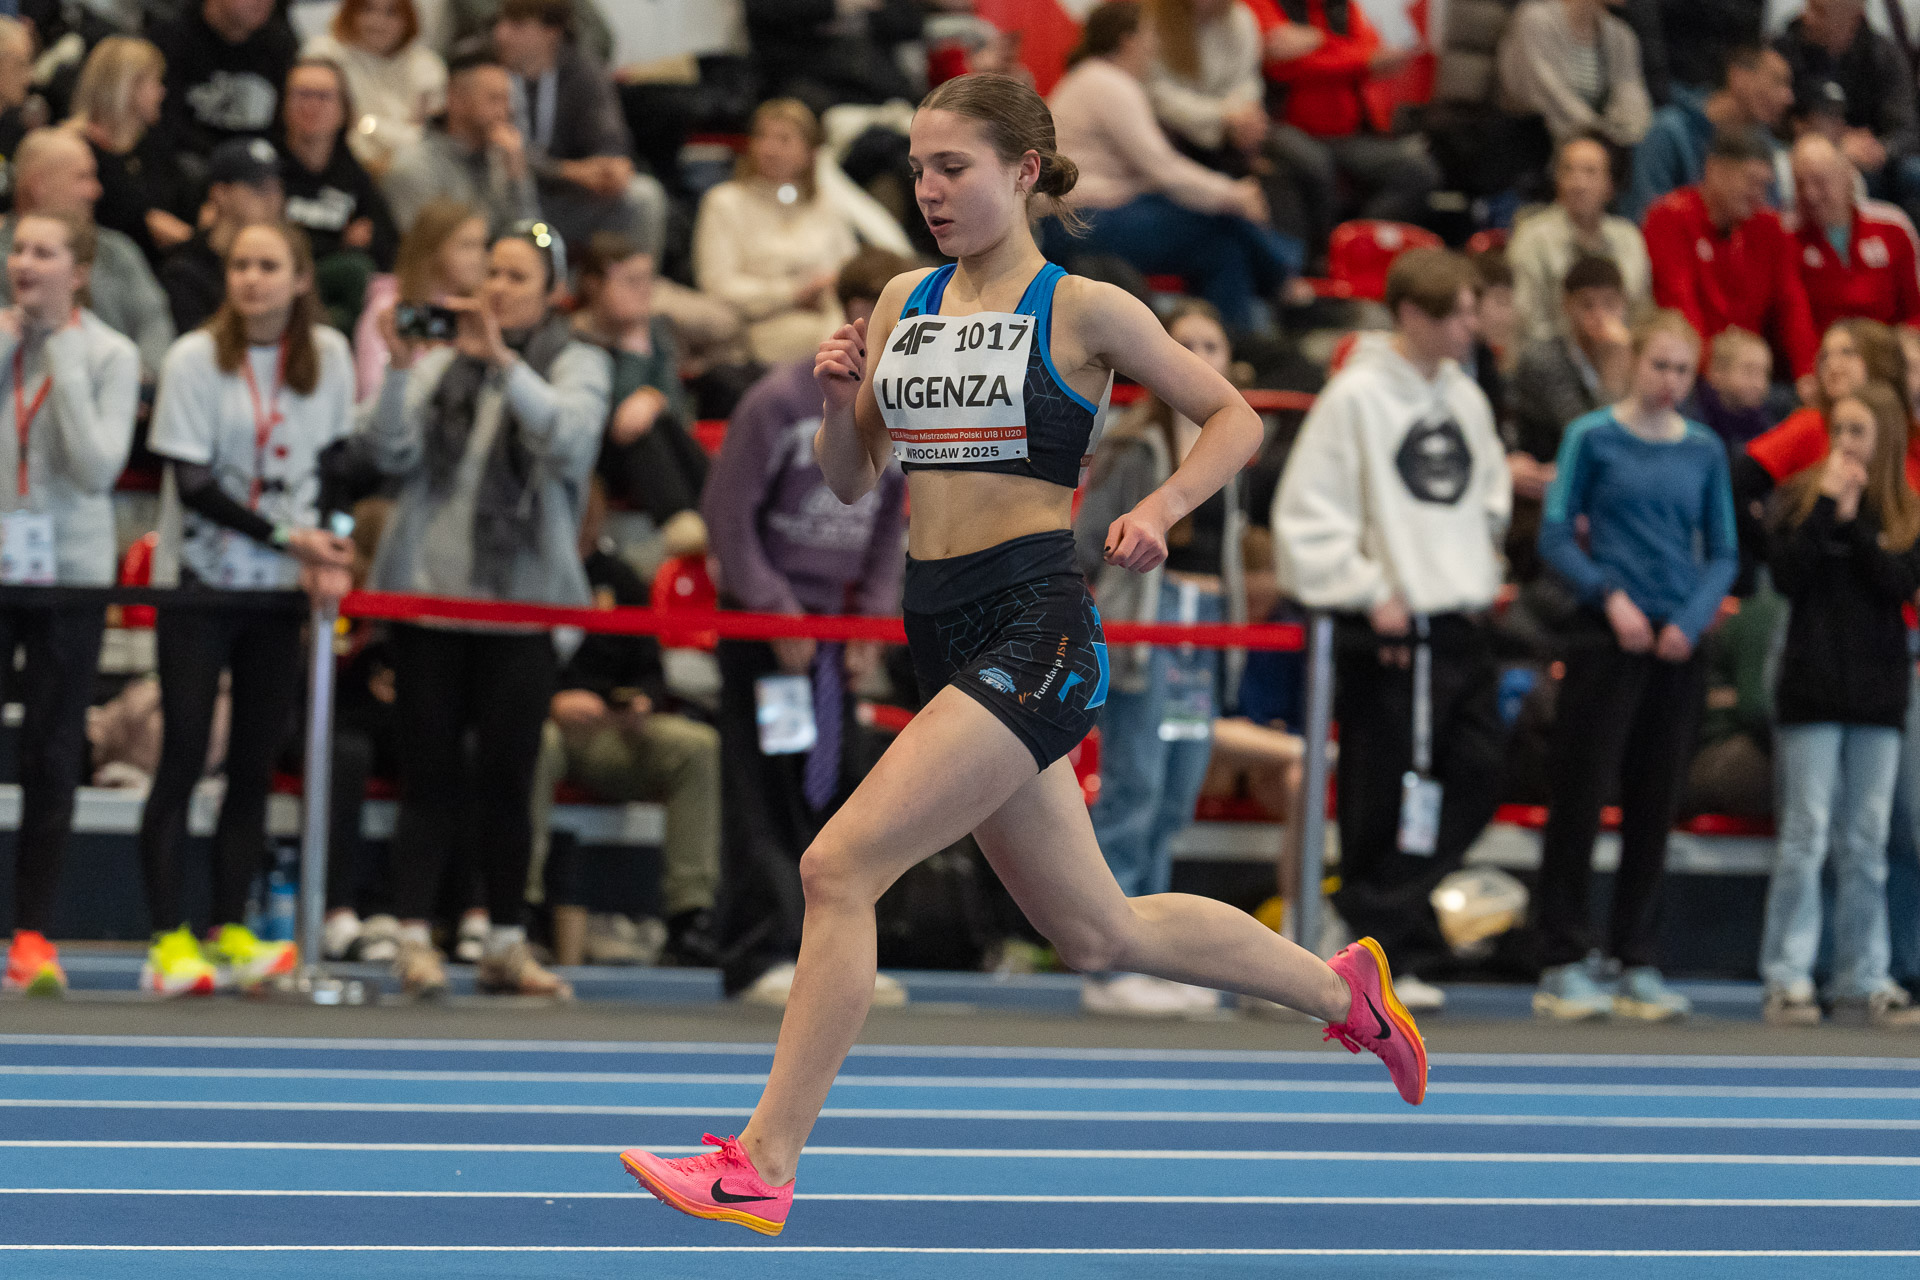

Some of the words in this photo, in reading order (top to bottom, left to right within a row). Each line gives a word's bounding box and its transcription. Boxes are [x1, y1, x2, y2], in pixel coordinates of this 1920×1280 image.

[892, 322, 946, 355] 4F
[954, 322, 1029, 352] 1017
[881, 374, 1013, 410] LIGENZA
[919, 432, 959, 440] Mistrzostwa
[960, 431, 982, 439] Polski
[983, 430, 999, 439] U18
[1004, 429, 1022, 438] U20
[905, 447, 959, 459] WROCŁAW
[962, 445, 1000, 458] 2025
[1033, 659, 1064, 700] Fundacja
[1056, 633, 1069, 657] JSW
